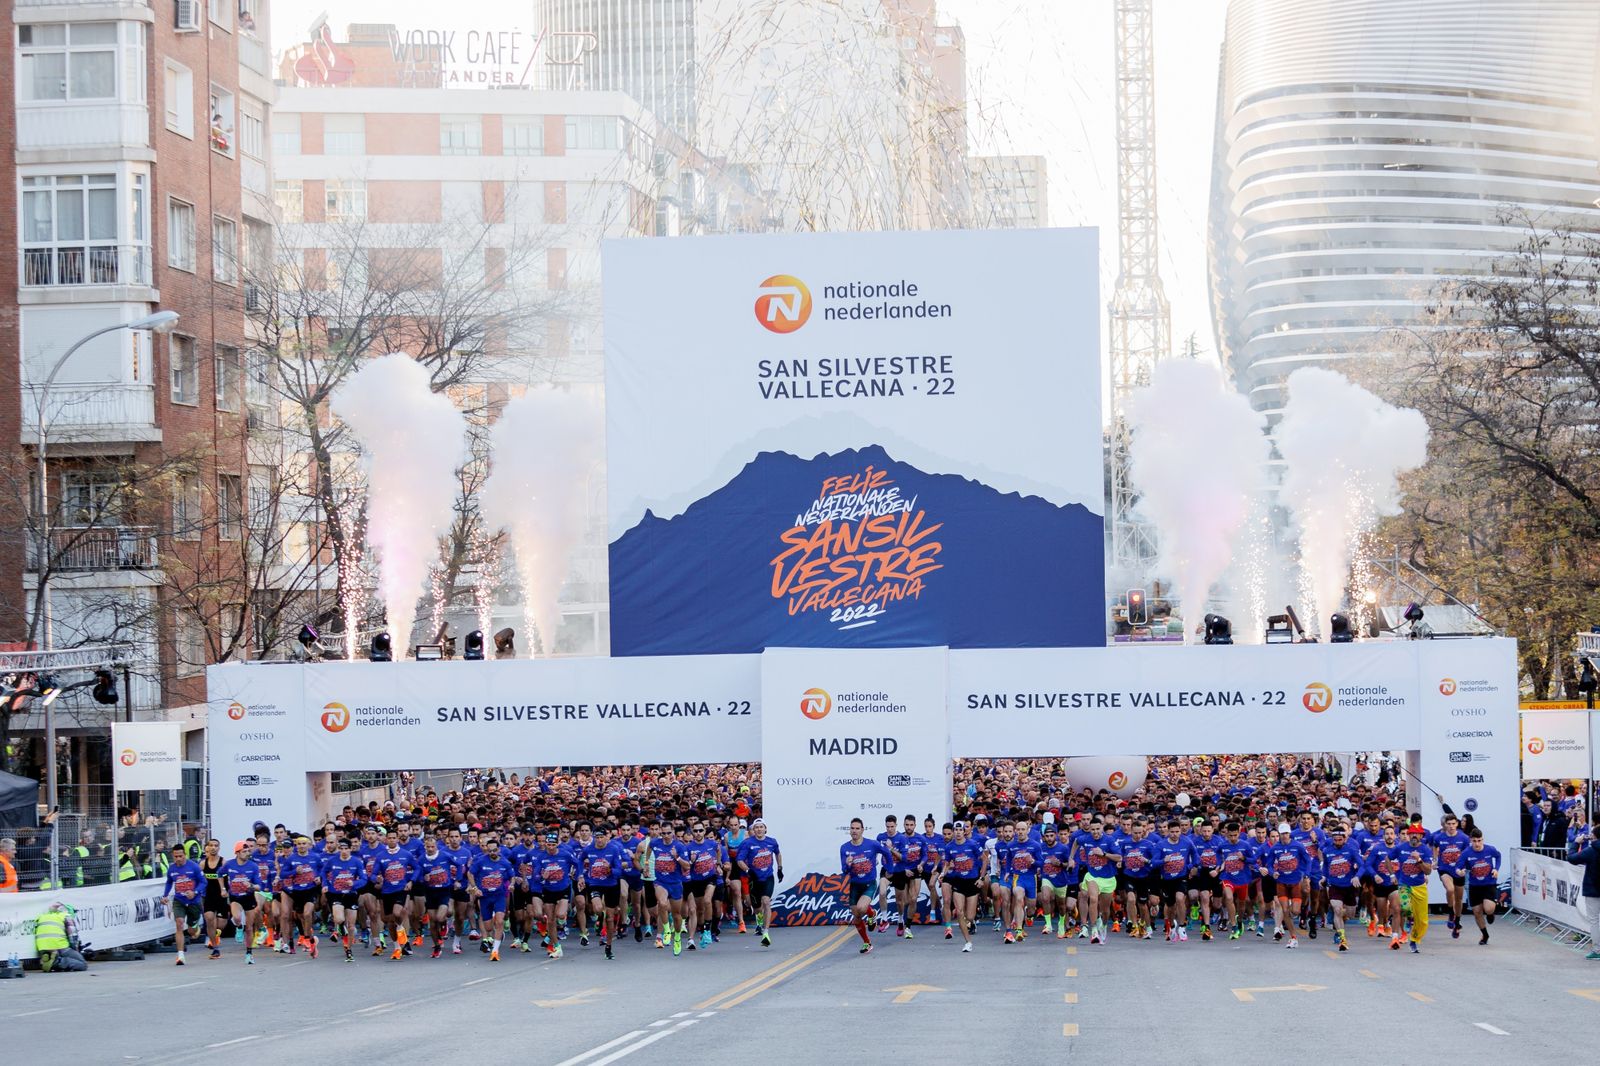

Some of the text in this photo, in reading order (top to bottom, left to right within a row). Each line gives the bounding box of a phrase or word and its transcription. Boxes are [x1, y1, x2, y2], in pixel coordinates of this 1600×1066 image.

[387, 29, 457, 63] WORK
[825, 280, 918, 298] nationale
[825, 301, 951, 320] nederlanden
[759, 356, 953, 378] SAN SILVESTRE
[758, 377, 955, 399] VALLECANA 22
[811, 487, 900, 512] NATIONALE
[795, 494, 918, 526] NEDERLANDEN
[771, 542, 944, 598] VESTRE
[788, 577, 926, 616] VALLECANA
[830, 603, 886, 623] 2022
[838, 692, 888, 701] nationale
[1339, 685, 1387, 695] nationale
[838, 703, 906, 713] nederlanden
[968, 691, 1285, 709] SAN SILVESTRE VALLECANA 22
[1339, 694, 1404, 706] nederlanden
[356, 705, 403, 715] nationale
[437, 701, 751, 722] SAN SILVESTRE VALLECANA 22
[1451, 708, 1486, 716] OYSHO
[356, 714, 420, 726] nederlanden
[240, 732, 274, 742] OYSHO
[810, 738, 897, 755] MADRID
[1457, 775, 1484, 783] MARCA
[245, 798, 272, 806] MARCA
